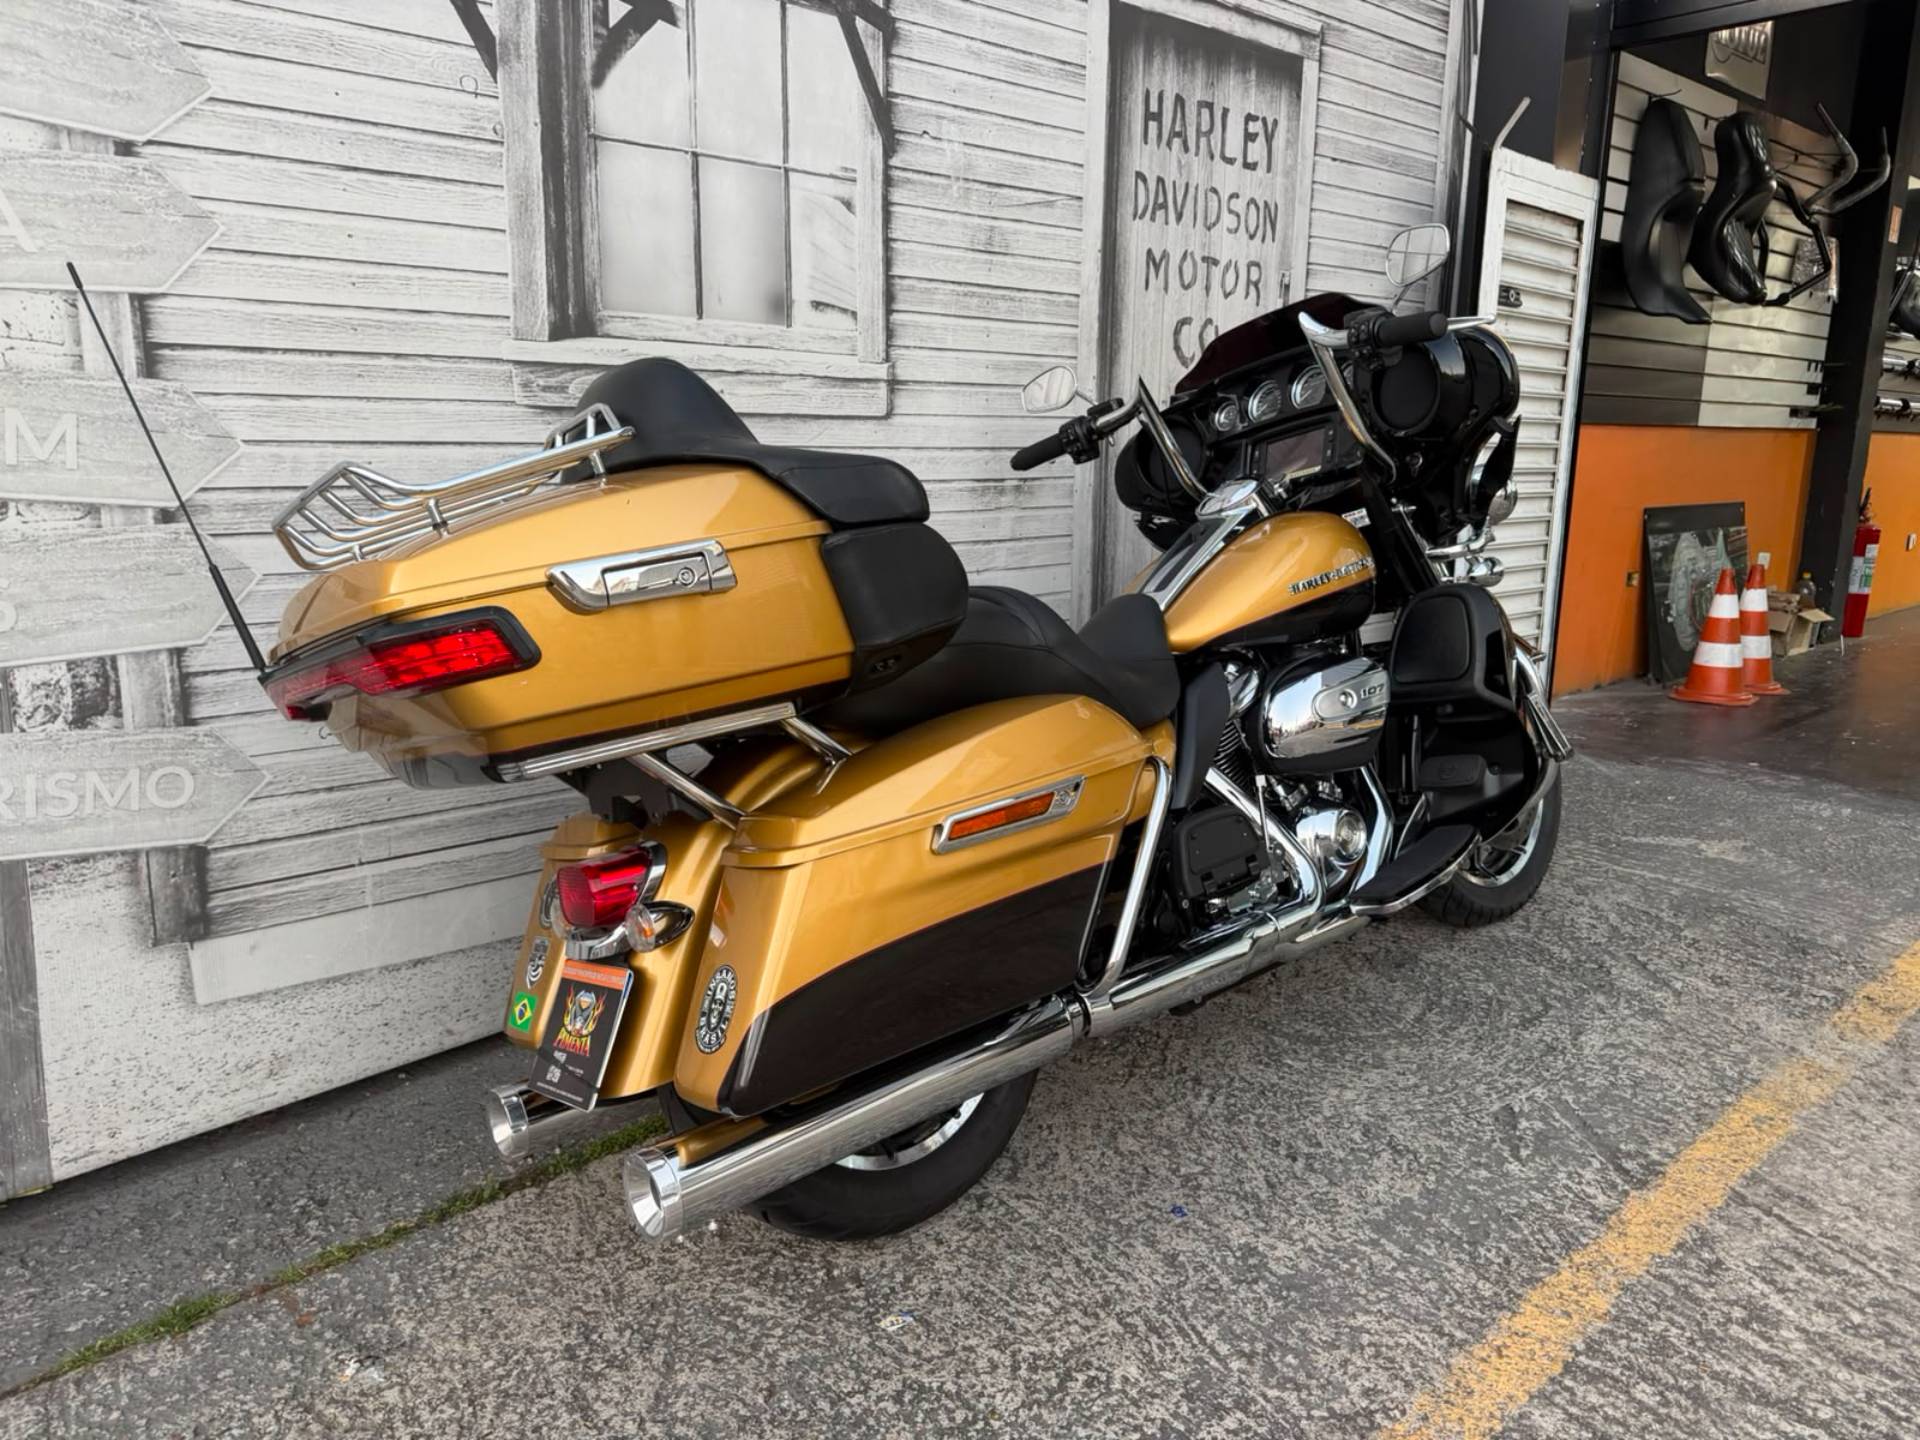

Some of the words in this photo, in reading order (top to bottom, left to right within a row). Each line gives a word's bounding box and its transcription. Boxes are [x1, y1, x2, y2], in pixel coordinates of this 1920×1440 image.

[1142, 87, 1279, 174] HARLEY
[1132, 170, 1279, 244] DAVIDSON
[1144, 247, 1263, 307] MOTOR
[1361, 682, 1385, 699] 107
